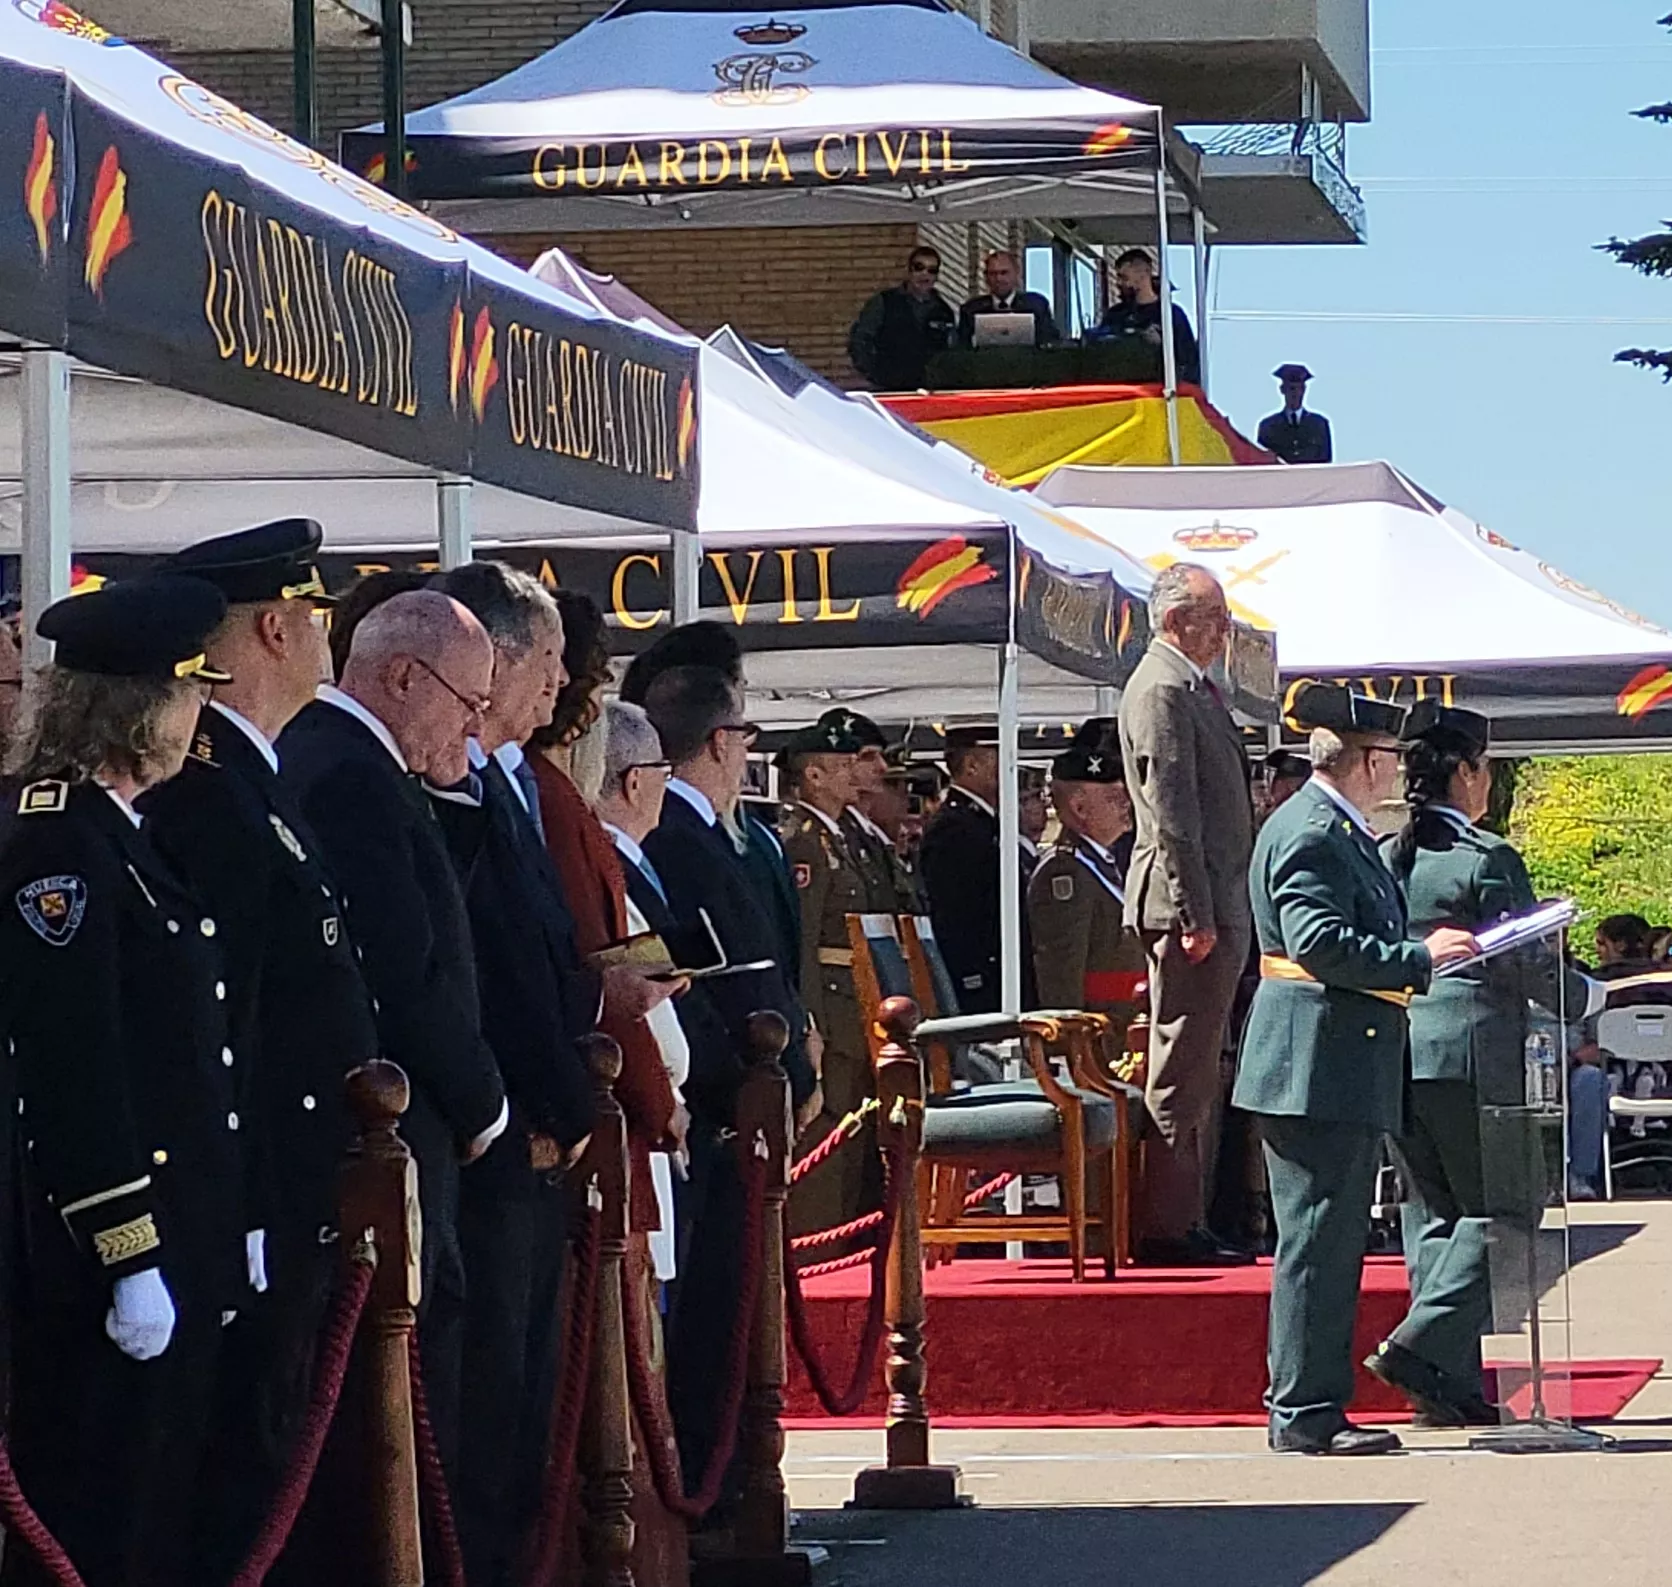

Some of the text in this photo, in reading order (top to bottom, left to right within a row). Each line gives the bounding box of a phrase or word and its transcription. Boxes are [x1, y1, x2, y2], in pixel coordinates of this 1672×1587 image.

[532, 128, 970, 190] GUARDIA CIVIL
[202, 189, 418, 417] GUARDIA CIVIL
[507, 322, 674, 481] GUARDIA CIVIL
[611, 546, 862, 630] CVIL
